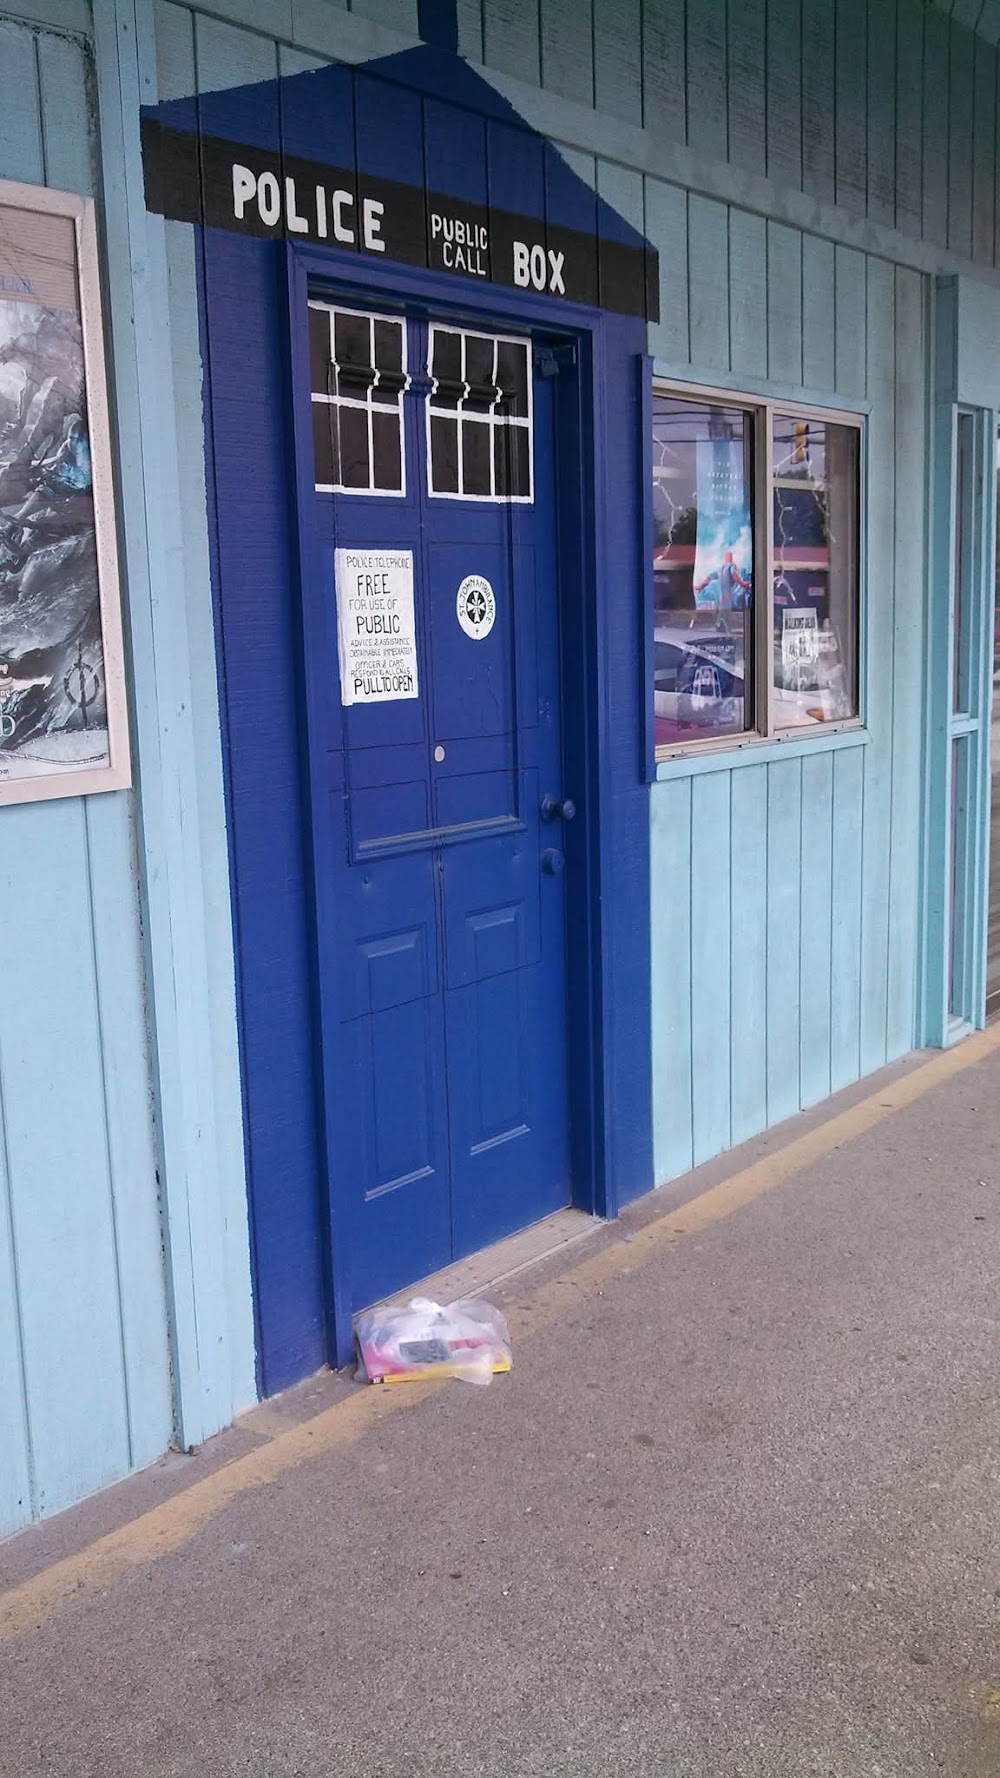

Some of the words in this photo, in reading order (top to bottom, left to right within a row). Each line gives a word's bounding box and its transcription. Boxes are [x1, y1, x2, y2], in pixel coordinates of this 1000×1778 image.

[232, 163, 385, 252] POLICE
[431, 213, 488, 250] PUBLIC
[442, 241, 486, 276] CALL
[513, 241, 566, 295] BOX
[346, 555, 373, 568] POLICE
[375, 557, 410, 569] TELEPHONE
[357, 573, 391, 596] FREE
[349, 598, 368, 611] FOR
[369, 598, 385, 610] USE
[387, 598, 398, 610] OF
[356, 614, 401, 635] PUBLIC
[350, 638, 373, 647] ADVICE
[350, 669, 379, 678] RESPOND
[385, 668, 396, 676] ALL
[396, 666, 411, 675] CALLS
[389, 658, 405, 668] CARS
[354, 677, 383, 695] PULL
[381, 677, 392, 692] TO
[392, 675, 414, 692] OPEN
